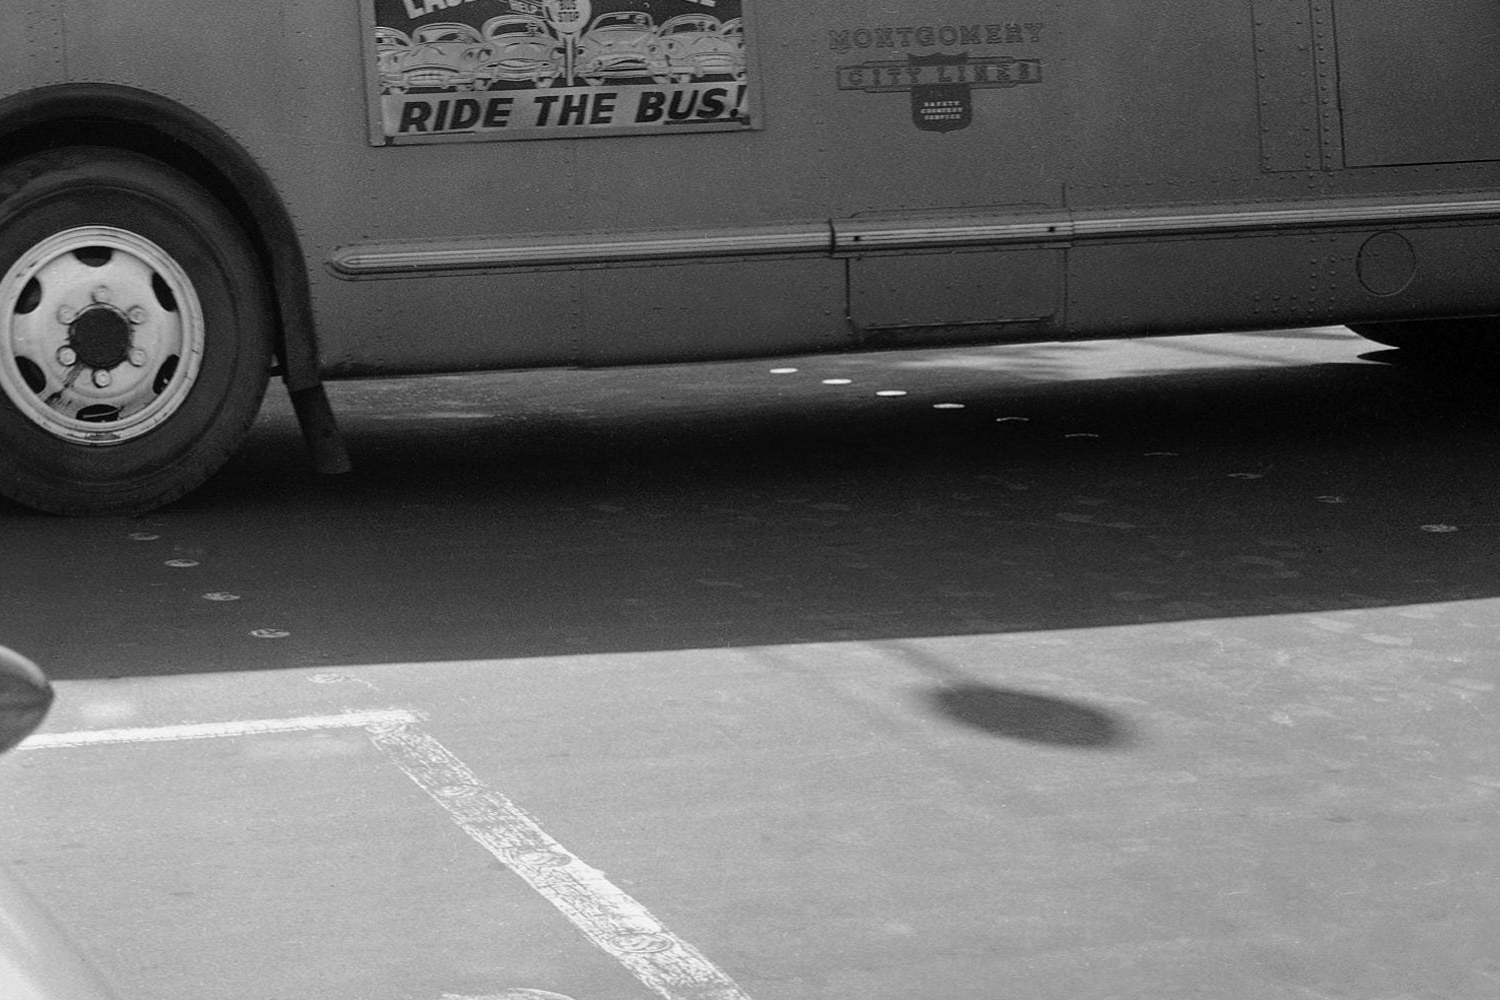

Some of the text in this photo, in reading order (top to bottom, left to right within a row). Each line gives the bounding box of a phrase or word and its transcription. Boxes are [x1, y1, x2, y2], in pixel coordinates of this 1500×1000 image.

[557, 10, 579, 22] STOP
[828, 22, 1044, 50] MONTGOMERY
[847, 63, 1031, 86] CITY LINES
[398, 84, 748, 133] RIDE THE BUS!
